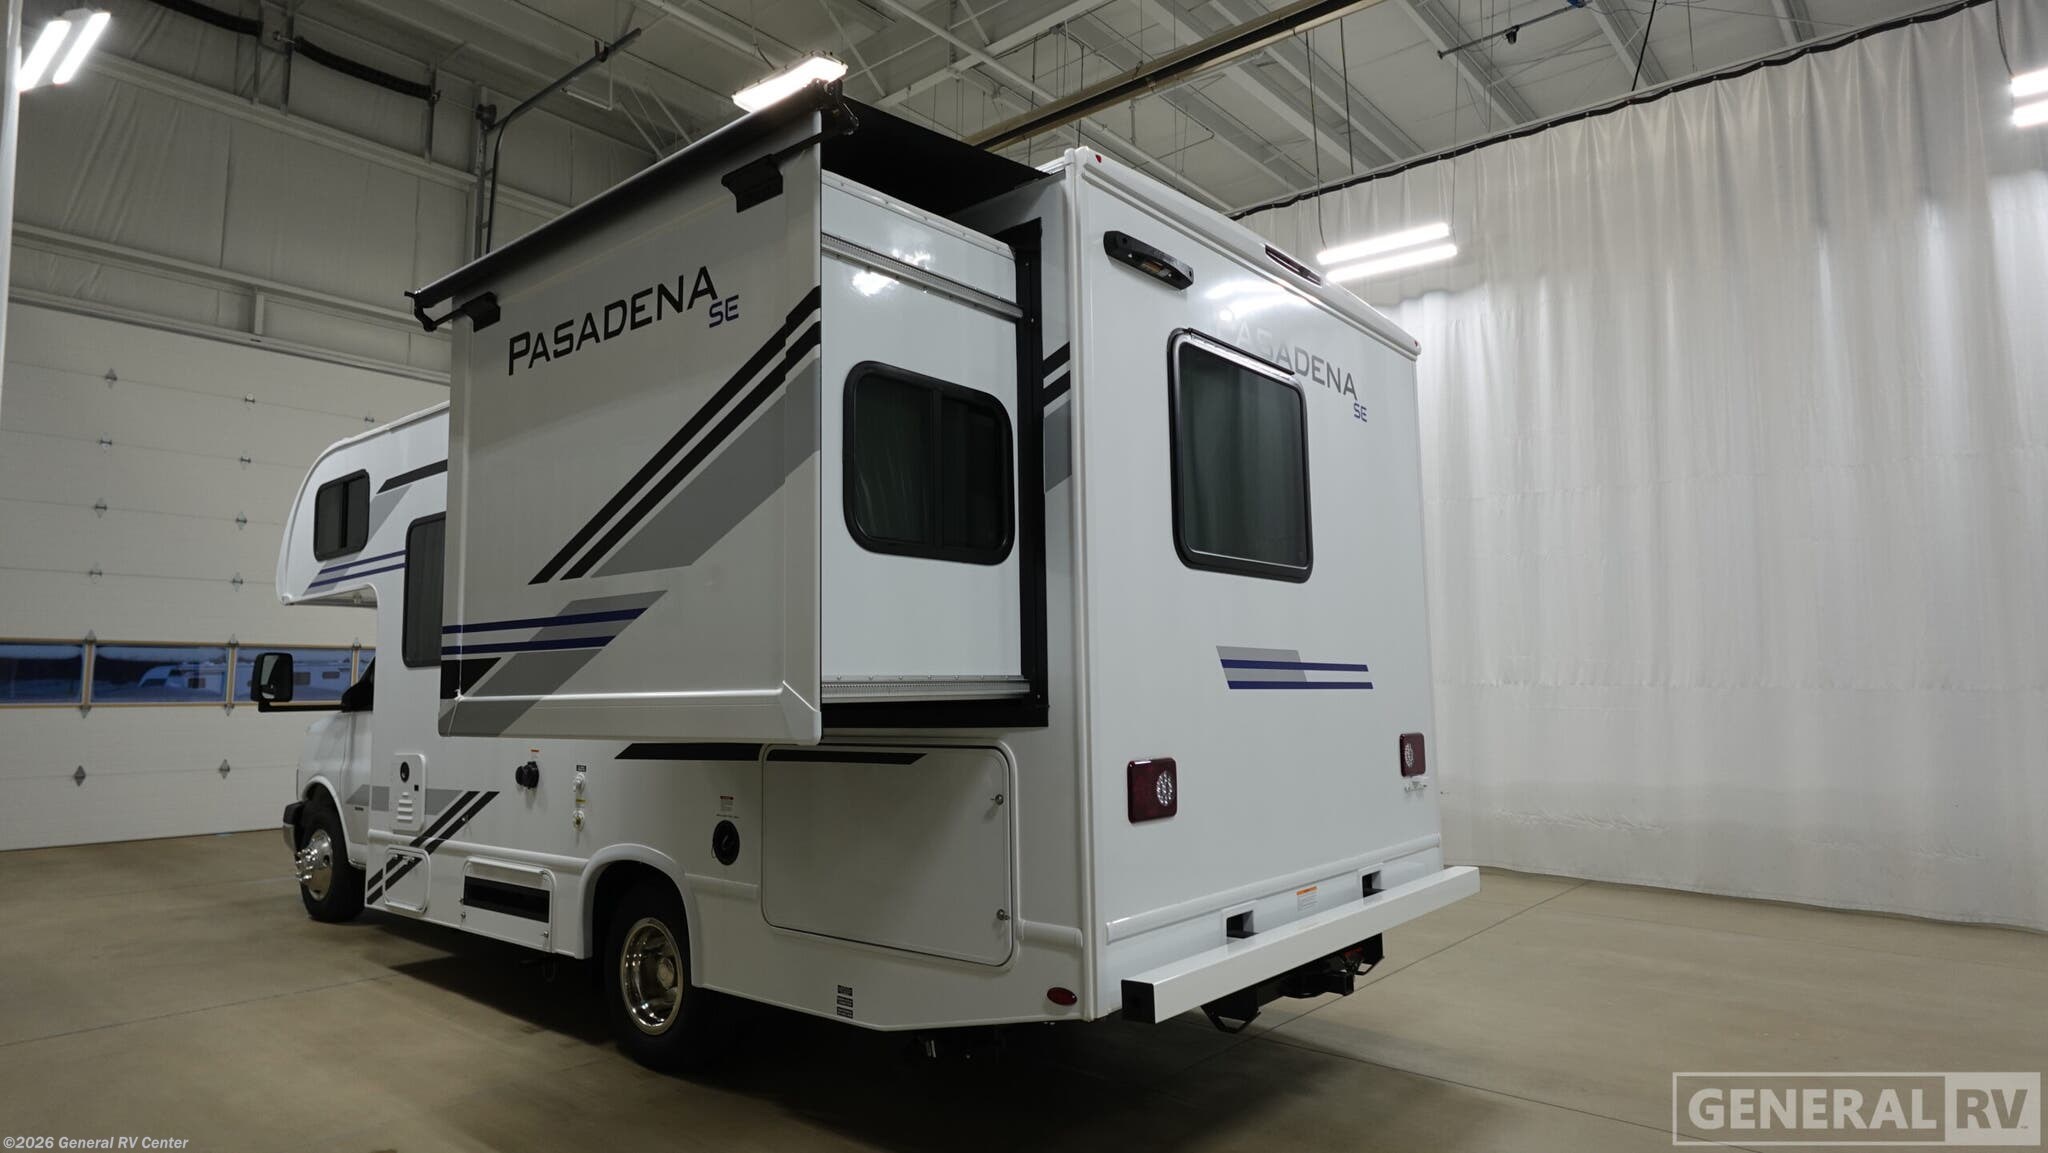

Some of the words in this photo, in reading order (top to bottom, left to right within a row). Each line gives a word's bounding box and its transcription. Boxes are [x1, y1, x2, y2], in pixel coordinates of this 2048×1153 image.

[509, 265, 719, 377] PASADENA
[708, 294, 740, 329] SE
[1353, 402, 1368, 423] SE
